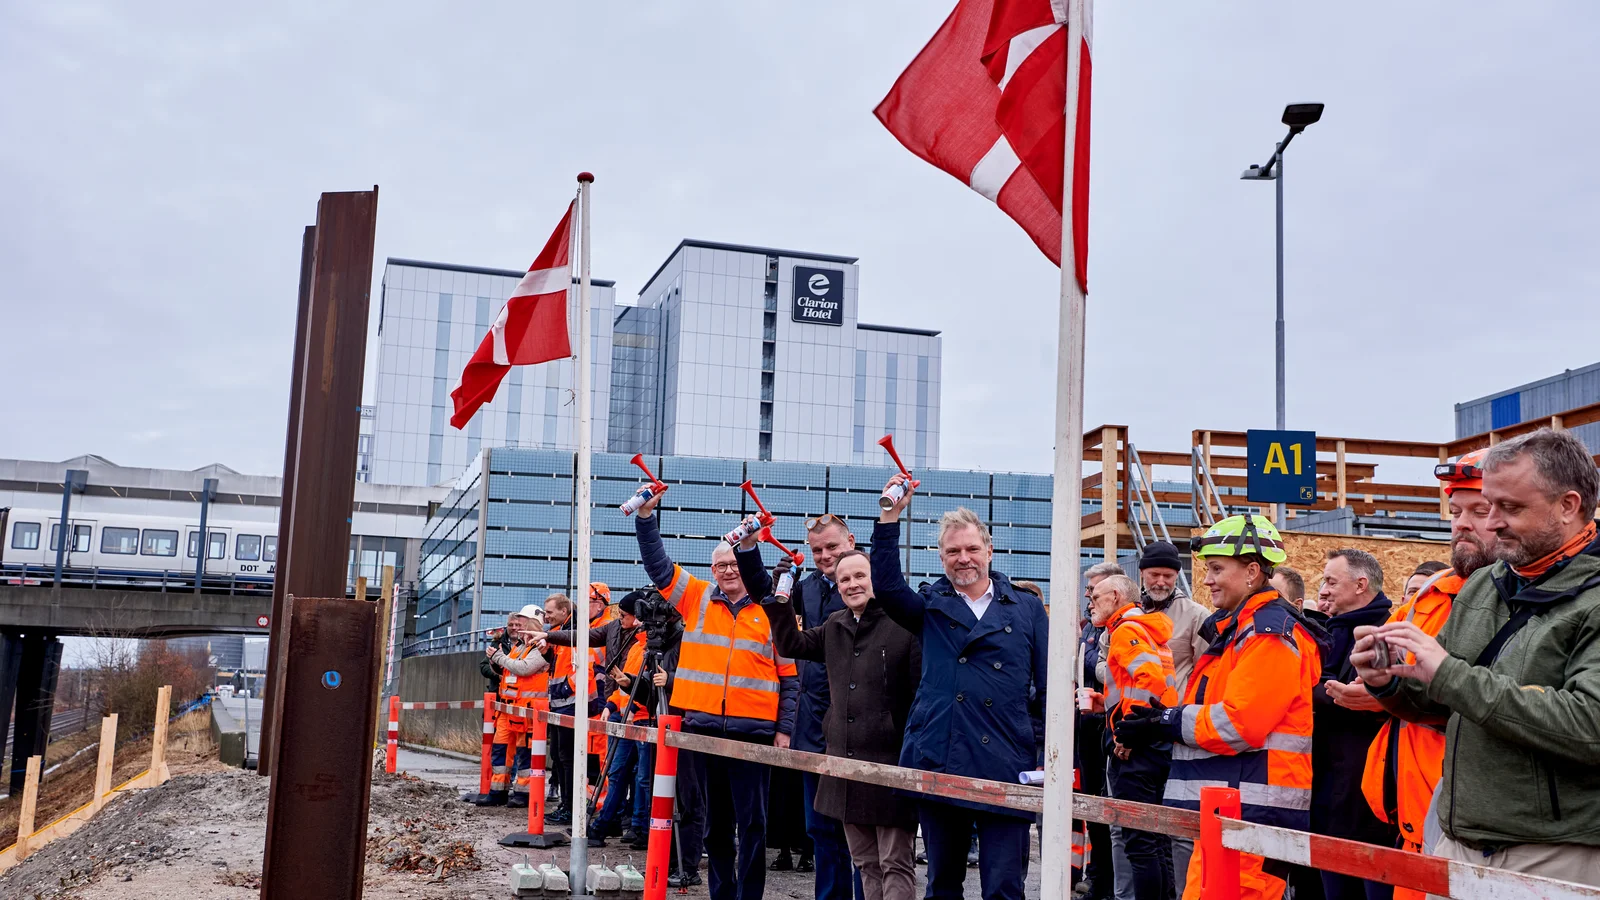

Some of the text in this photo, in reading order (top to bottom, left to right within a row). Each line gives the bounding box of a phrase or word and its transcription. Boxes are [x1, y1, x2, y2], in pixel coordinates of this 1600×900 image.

[797, 296, 838, 310] Clarion
[802, 307, 833, 320] Hotel
[1263, 442, 1302, 475] A1
[1306, 491, 1312, 499] 5
[240, 564, 259, 572] DOT
